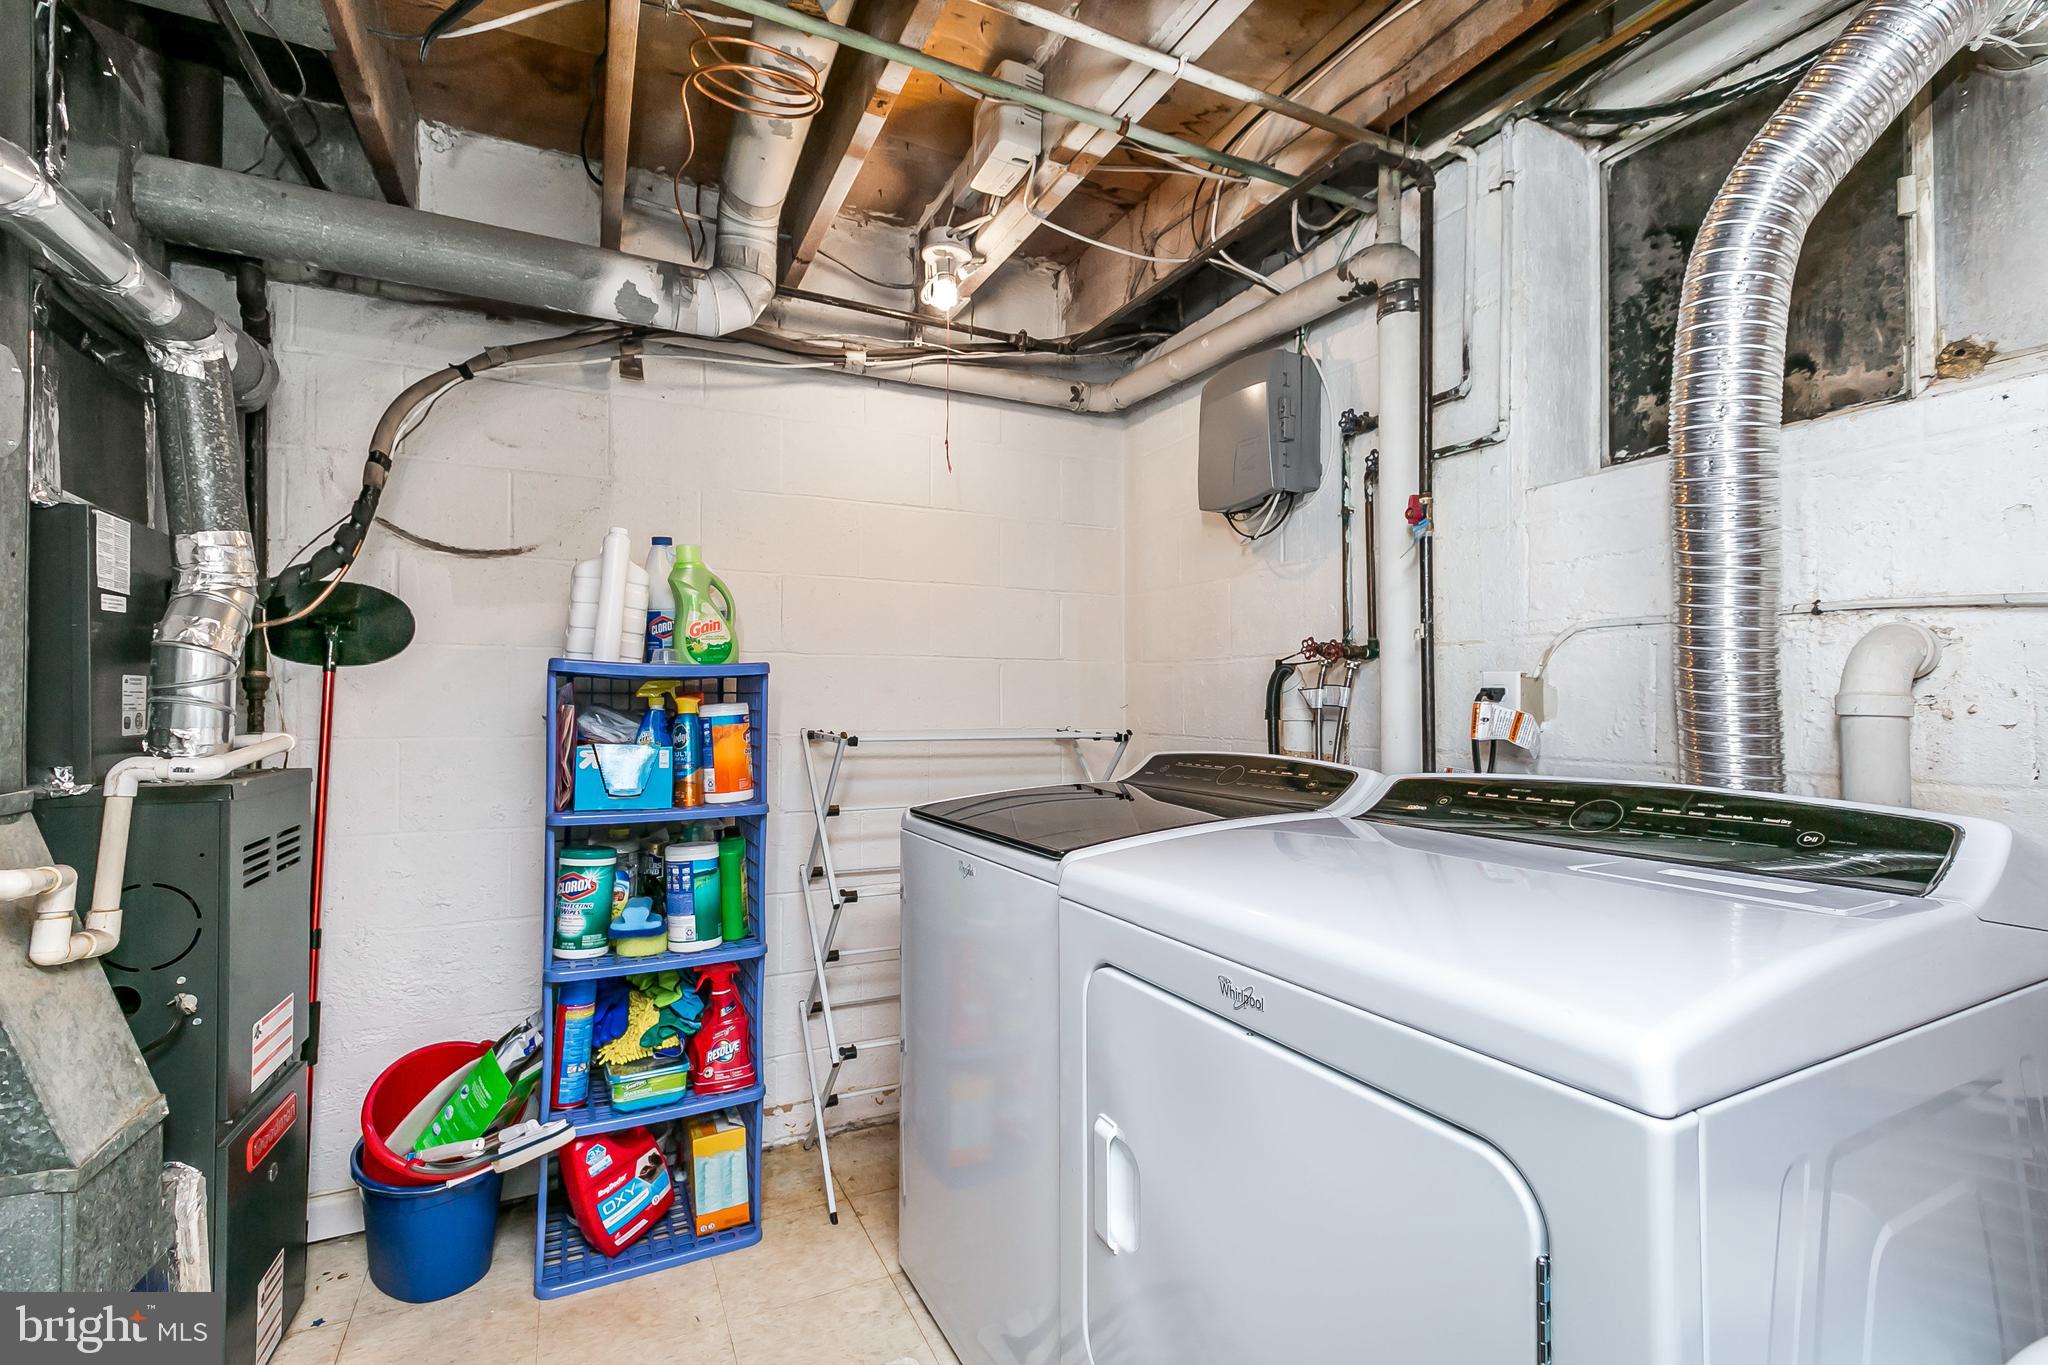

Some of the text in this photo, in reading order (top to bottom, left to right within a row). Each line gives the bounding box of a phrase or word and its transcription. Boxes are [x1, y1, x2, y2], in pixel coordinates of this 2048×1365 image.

[651, 621, 675, 635] CLORO
[689, 620, 721, 637] Gain
[557, 879, 592, 895] CLOROX
[1218, 976, 1265, 1013] Whirlpool
[706, 1040, 741, 1064] RESOLVE
[253, 1103, 296, 1157] Goodman
[602, 1182, 637, 1215] OXY
